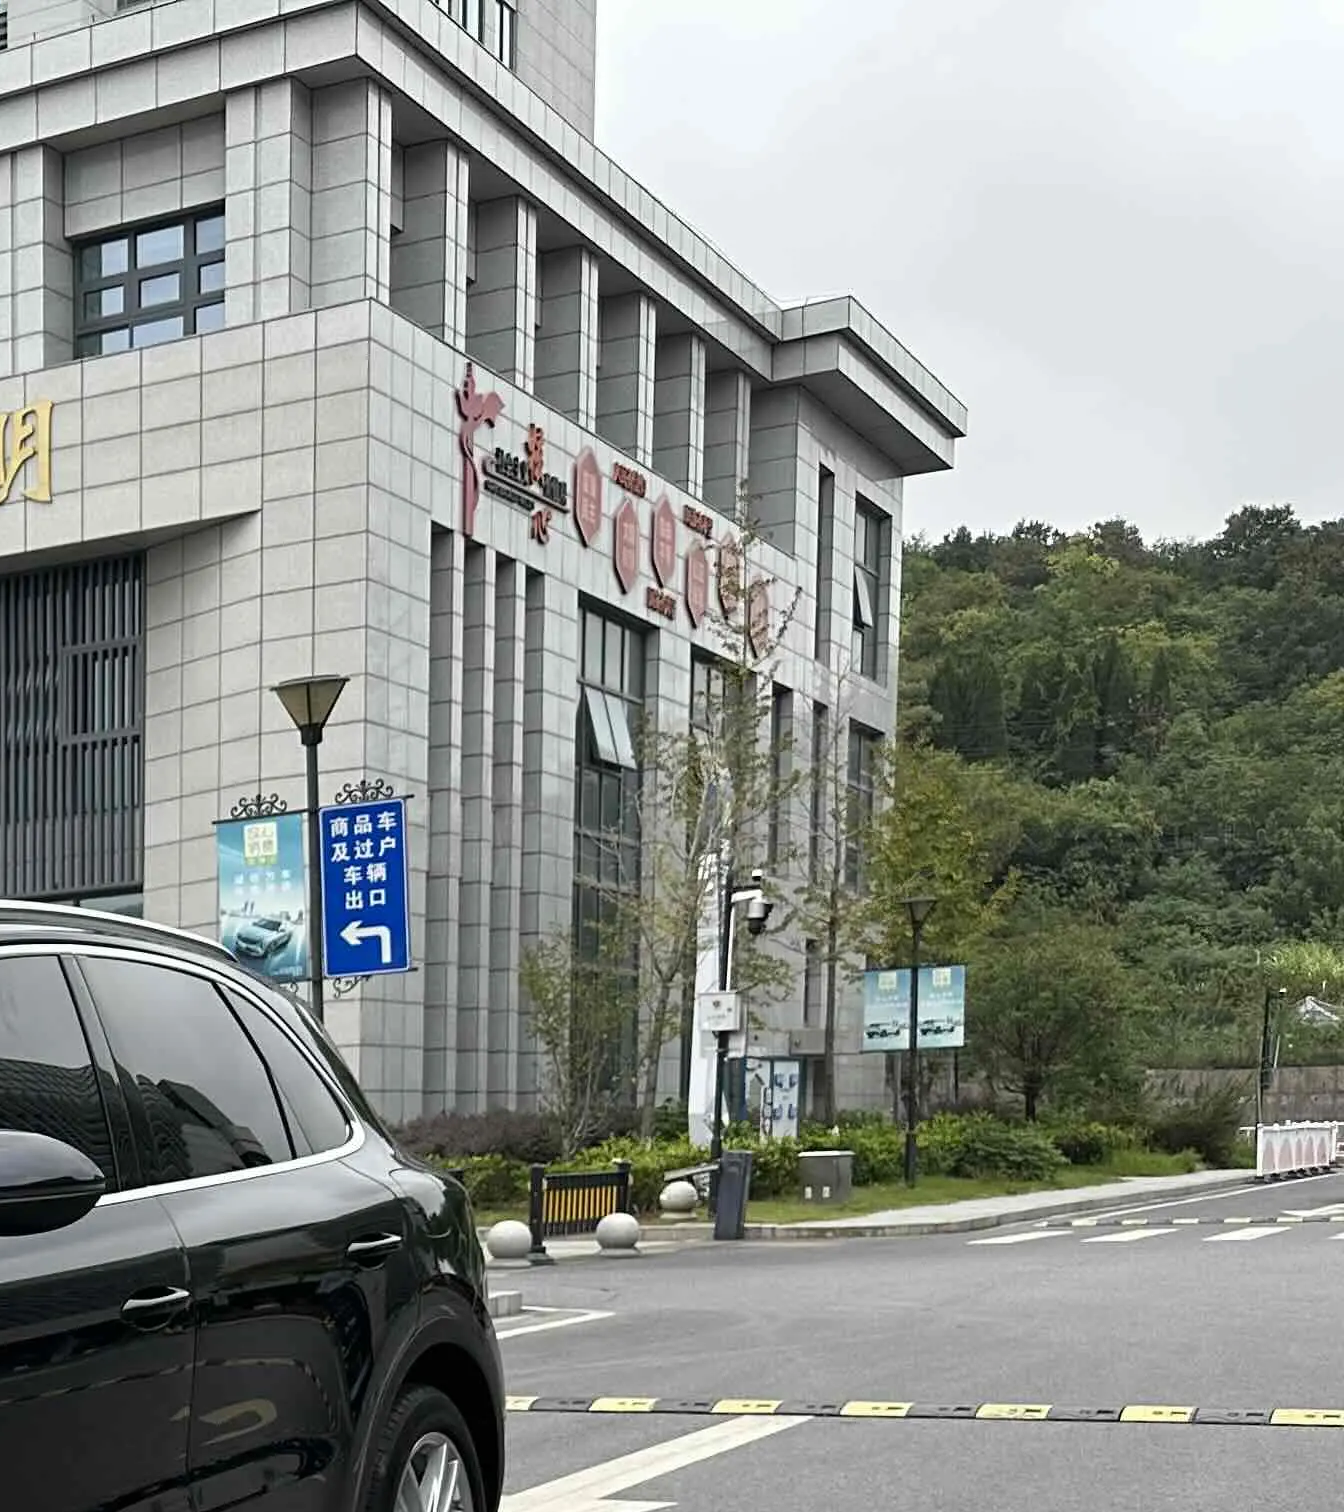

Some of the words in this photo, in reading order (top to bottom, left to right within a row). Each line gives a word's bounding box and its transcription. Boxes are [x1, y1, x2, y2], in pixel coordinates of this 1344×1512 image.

[329, 811, 397, 839] 商品车
[330, 836, 397, 863] 及过户
[343, 862, 388, 886] 车辆
[345, 888, 387, 911] 出口
